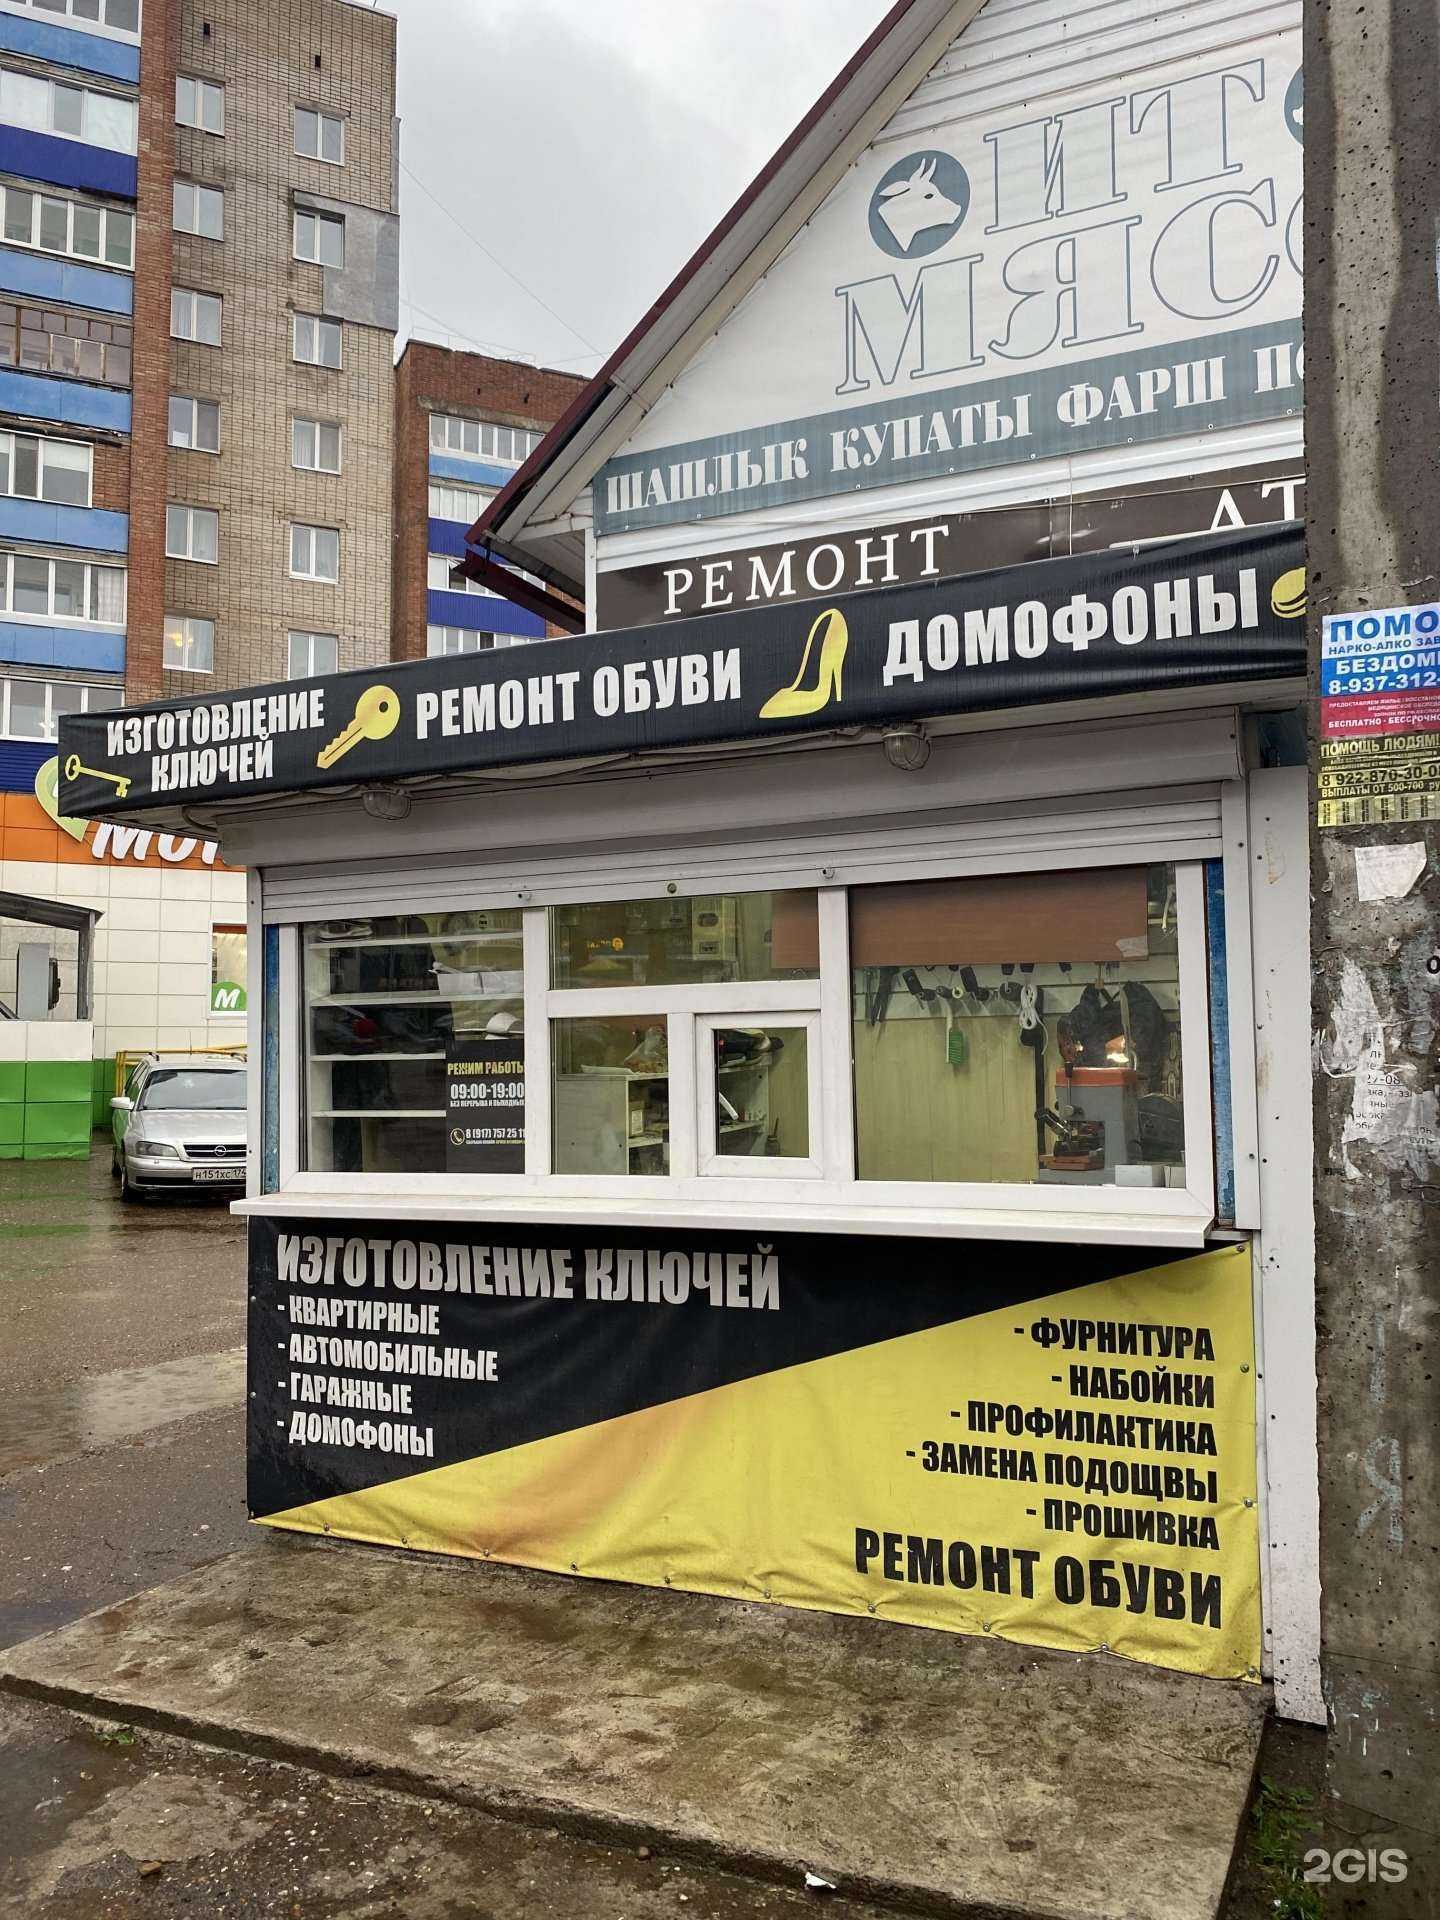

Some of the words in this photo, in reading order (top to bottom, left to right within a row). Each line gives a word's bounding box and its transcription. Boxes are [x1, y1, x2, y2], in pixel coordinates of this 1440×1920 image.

[606, 438, 810, 514] ШАШЛЫК
[830, 394, 1032, 472] КУПАТЫ
[1056, 355, 1228, 428] ФАРШ
[1253, 343, 1304, 393] П
[663, 525, 949, 615] РЕМОНТ
[107, 689, 325, 757] ИЗГОТОВЛЕНИЕ
[417, 671, 580, 740] РЕМОНТ
[594, 649, 742, 716] ОБУВИ
[883, 569, 1258, 687] ДОМОФОНЫ
[1329, 639, 1412, 655] НАРКО-АЛКО
[1328, 718, 1382, 729] БЕСПЛАТНО
[151, 733, 274, 793] КЛЮЧЕЙ
[1320, 740, 1380, 757] ПОМОЩЬ
[1321, 786, 1370, 798] ВЫПЛАТЫ
[1372, 784, 1386, 794] ОТ
[447, 1062, 484, 1075] РЕЖИМ
[450, 1082, 525, 1099] 09:00-19:00
[466, 1129, 471, 1138] 8
[472, 1128, 492, 1138] (917)
[507, 1128, 517, 1138] 25
[277, 1234, 573, 1299] ИЗГОТОВЛЕНИЕ
[584, 1242, 780, 1311] КЛЮЧЕЙ
[289, 1295, 440, 1336] КВАРТИРНЫЕ
[289, 1334, 499, 1382] АВТОМОБИЛЬНЫЕ
[1031, 1317, 1215, 1361] ФУРНИТУРА
[290, 1372, 413, 1415] ГАРАЖНЫЕ
[1069, 1365, 1215, 1409] НАБОЙКИ
[289, 1411, 434, 1458] ДОМОФОНЫ
[967, 1400, 1217, 1457] ПРОФИЛАКТИКА
[922, 1440, 1038, 1483] ЗАМЕНА
[1044, 1498, 1220, 1551] ПРОШИВКА
[854, 1527, 1040, 1599] РЕМОНТ
[1054, 1555, 1222, 1629] ОБУВИ
